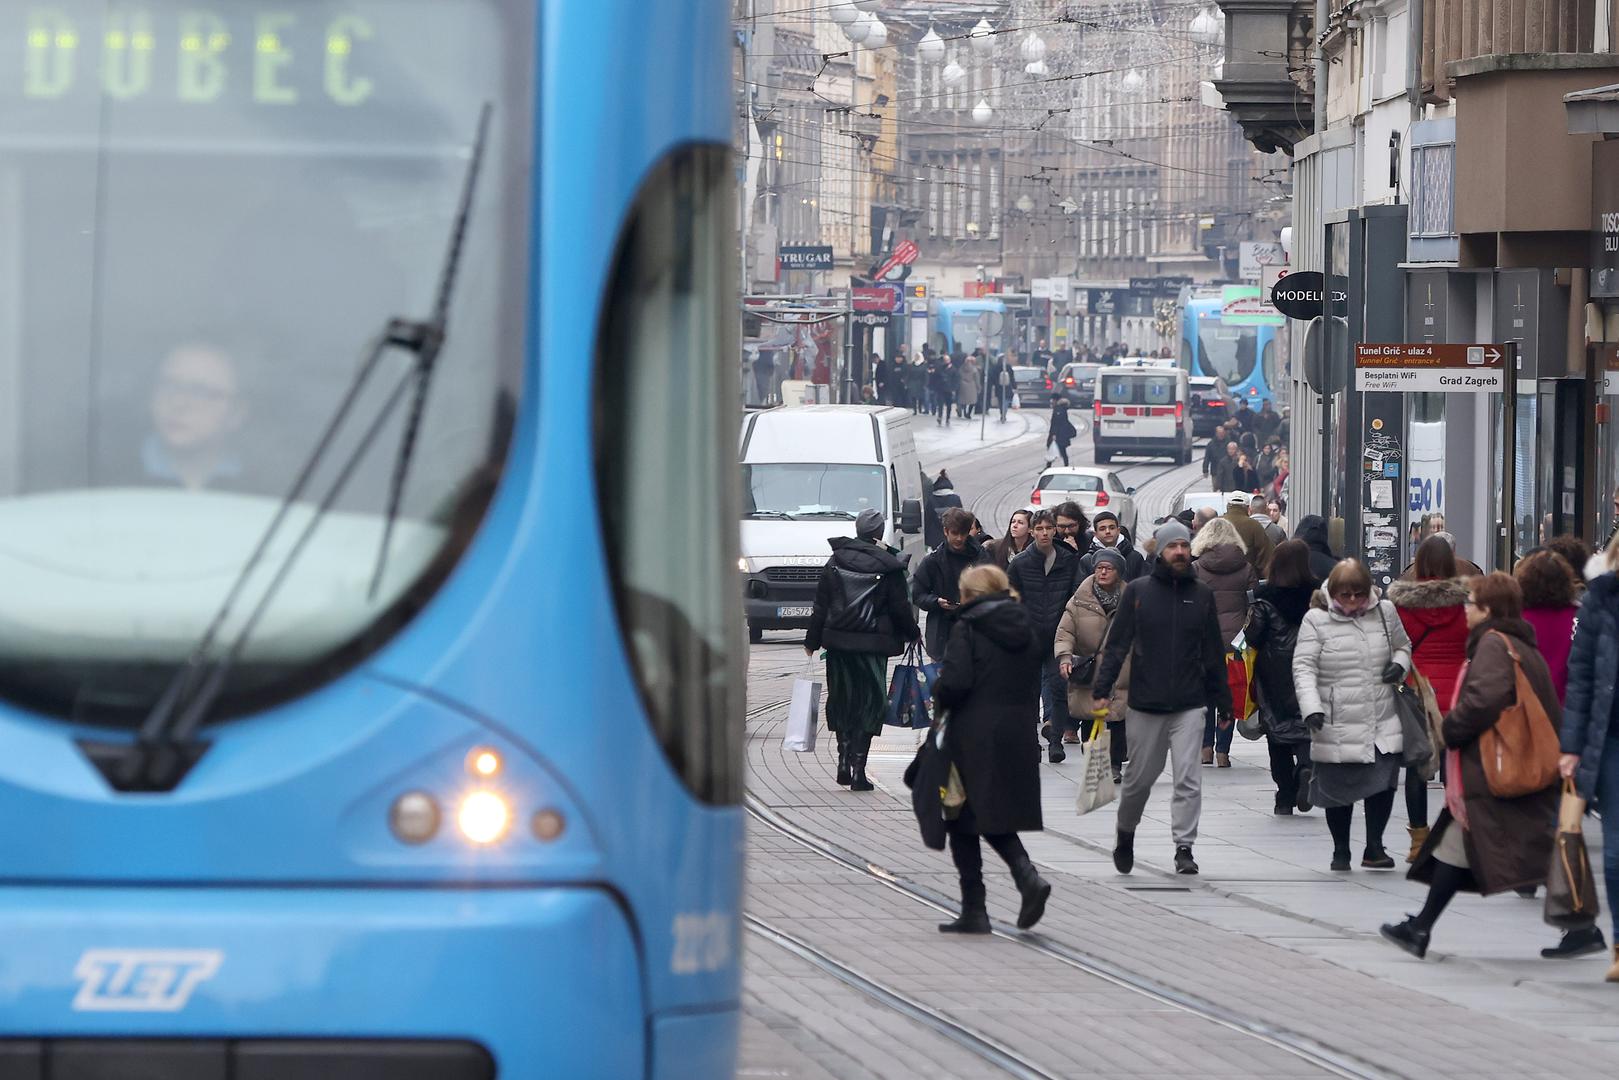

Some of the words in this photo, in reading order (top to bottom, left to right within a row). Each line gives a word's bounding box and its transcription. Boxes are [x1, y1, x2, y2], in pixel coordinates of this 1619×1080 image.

[24, 9, 374, 104] DUBEC
[1602, 213, 1619, 233] TOSC
[1359, 346, 1380, 355] Tunel
[1408, 346, 1425, 355] ulaz
[1427, 347, 1432, 355] 4
[1365, 372, 1398, 380] Besplatni
[1440, 376, 1462, 385] Grad
[1465, 376, 1498, 387] Zagreb
[783, 557, 821, 566] IVECO
[782, 607, 791, 616] ZG
